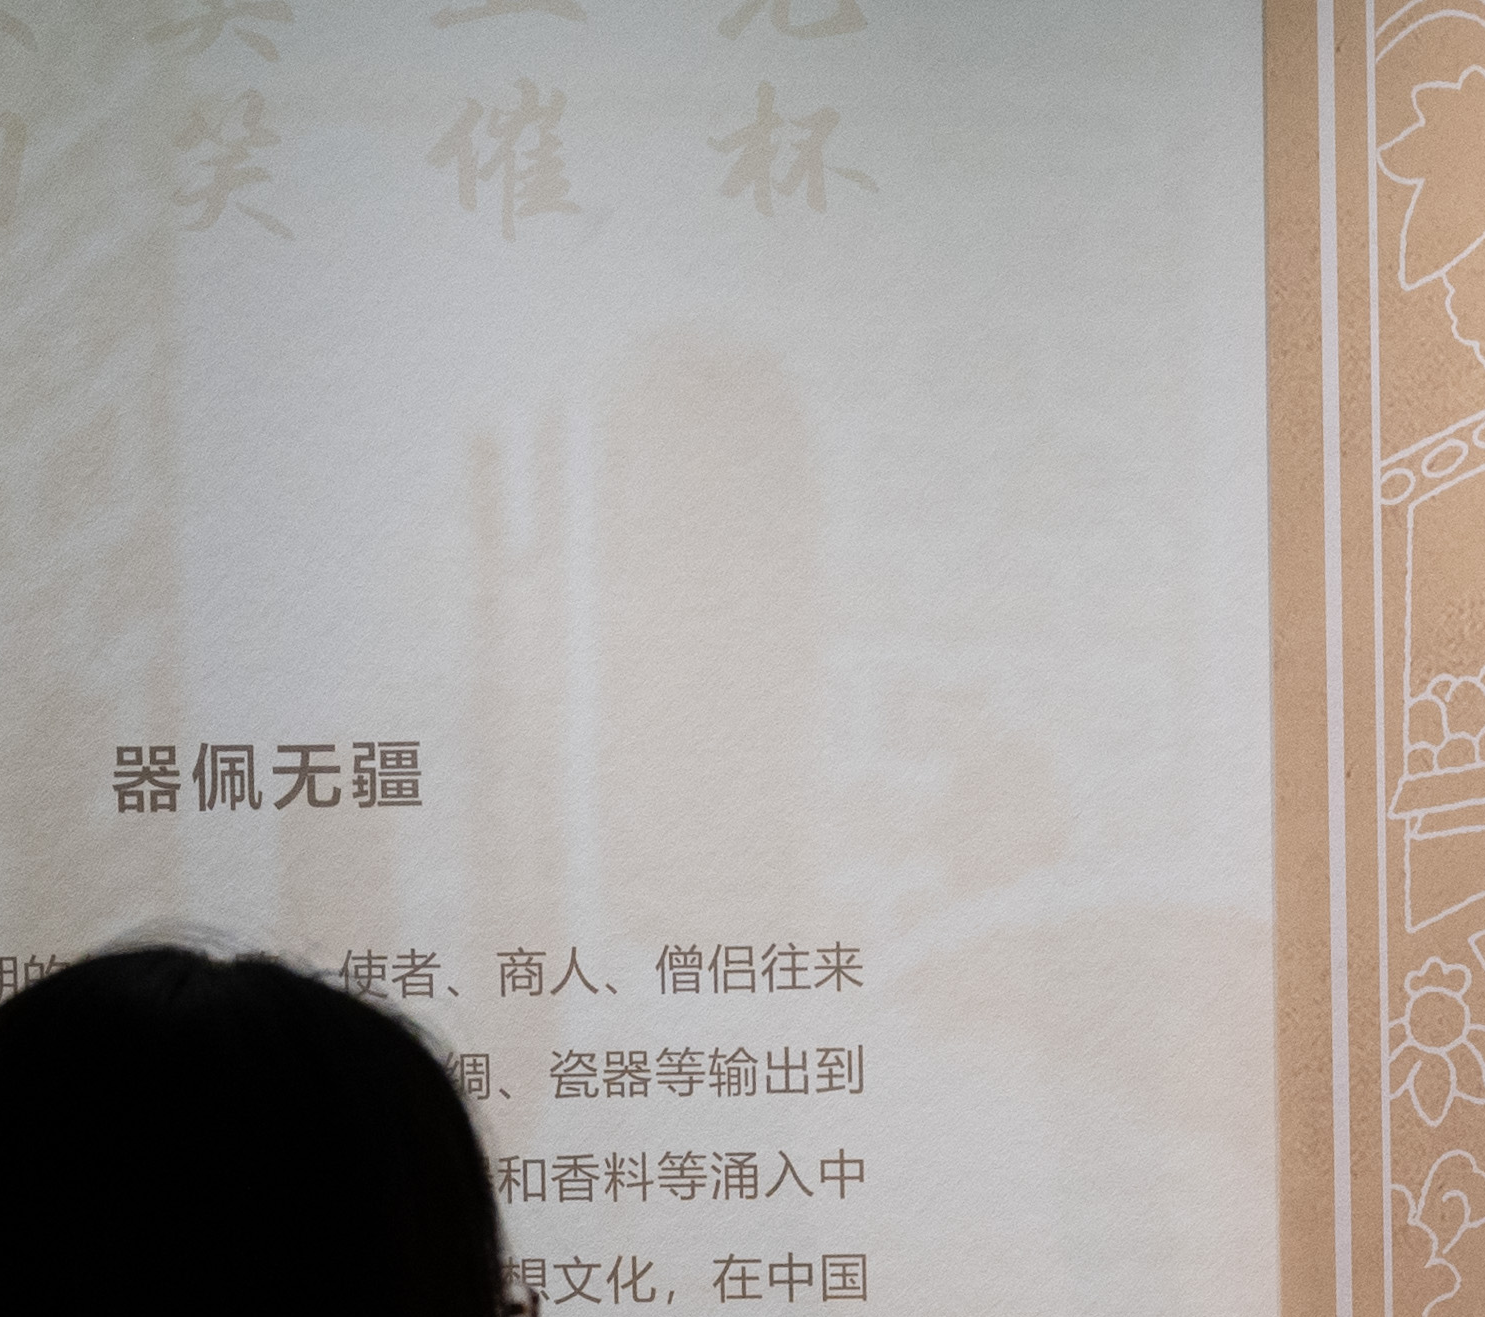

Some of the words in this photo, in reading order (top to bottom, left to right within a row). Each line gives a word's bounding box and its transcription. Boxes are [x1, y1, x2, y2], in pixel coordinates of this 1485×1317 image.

[429, 0, 588, 243] 催
[111, 739, 425, 815] 器佩无疆
